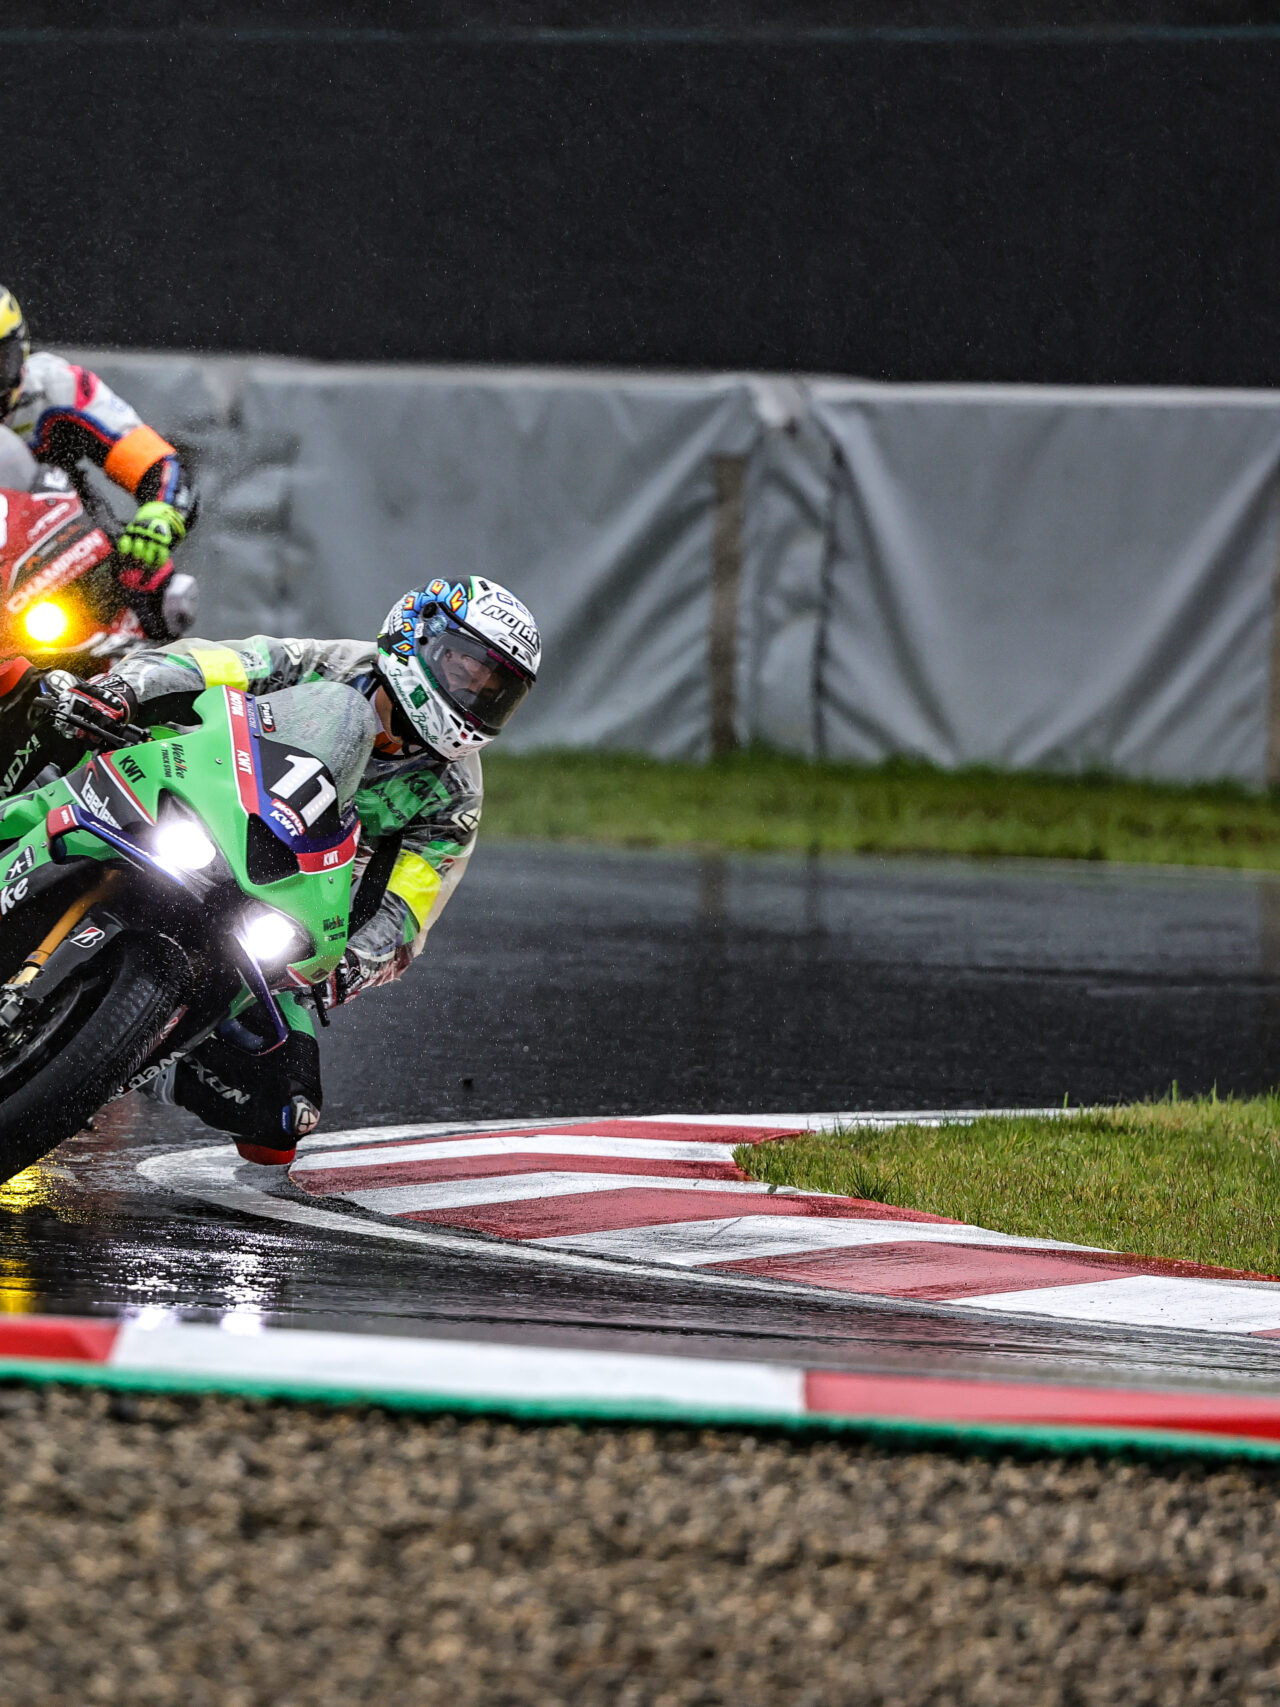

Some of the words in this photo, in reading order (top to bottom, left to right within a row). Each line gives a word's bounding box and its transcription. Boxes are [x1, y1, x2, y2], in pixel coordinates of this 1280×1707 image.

[6, 532, 104, 613] CHAMPION
[259, 703, 273, 726] Puig
[118, 755, 147, 783] KWT
[236, 749, 252, 775] KWT
[270, 755, 337, 827] 11
[269, 810, 300, 837] KWT
[272, 800, 306, 836] MOTUL
[322, 851, 339, 867] KWT
